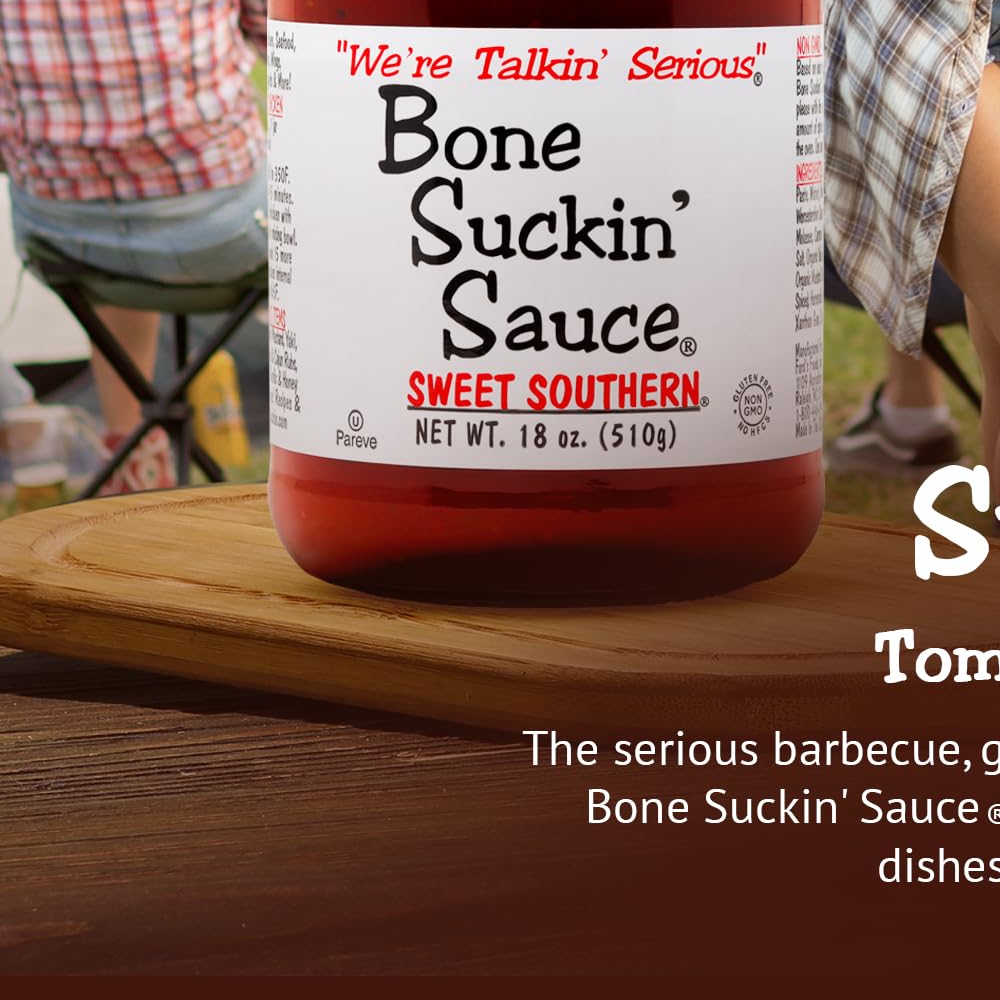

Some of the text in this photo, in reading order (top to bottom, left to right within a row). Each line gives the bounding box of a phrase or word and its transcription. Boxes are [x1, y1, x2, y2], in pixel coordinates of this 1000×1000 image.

[475, 46, 608, 81] Talkin'
[379, 85, 580, 174] Bone
[411, 177, 690, 266] Suckin'
[407, 370, 516, 409] SWEET
[733, 374, 774, 402] GLUTEN FREE
[744, 394, 762, 405] NON
[743, 405, 762, 416] GMO
[336, 429, 378, 449] Pareve
[416, 418, 677, 453] NET WT. 18 oz. (510g)
